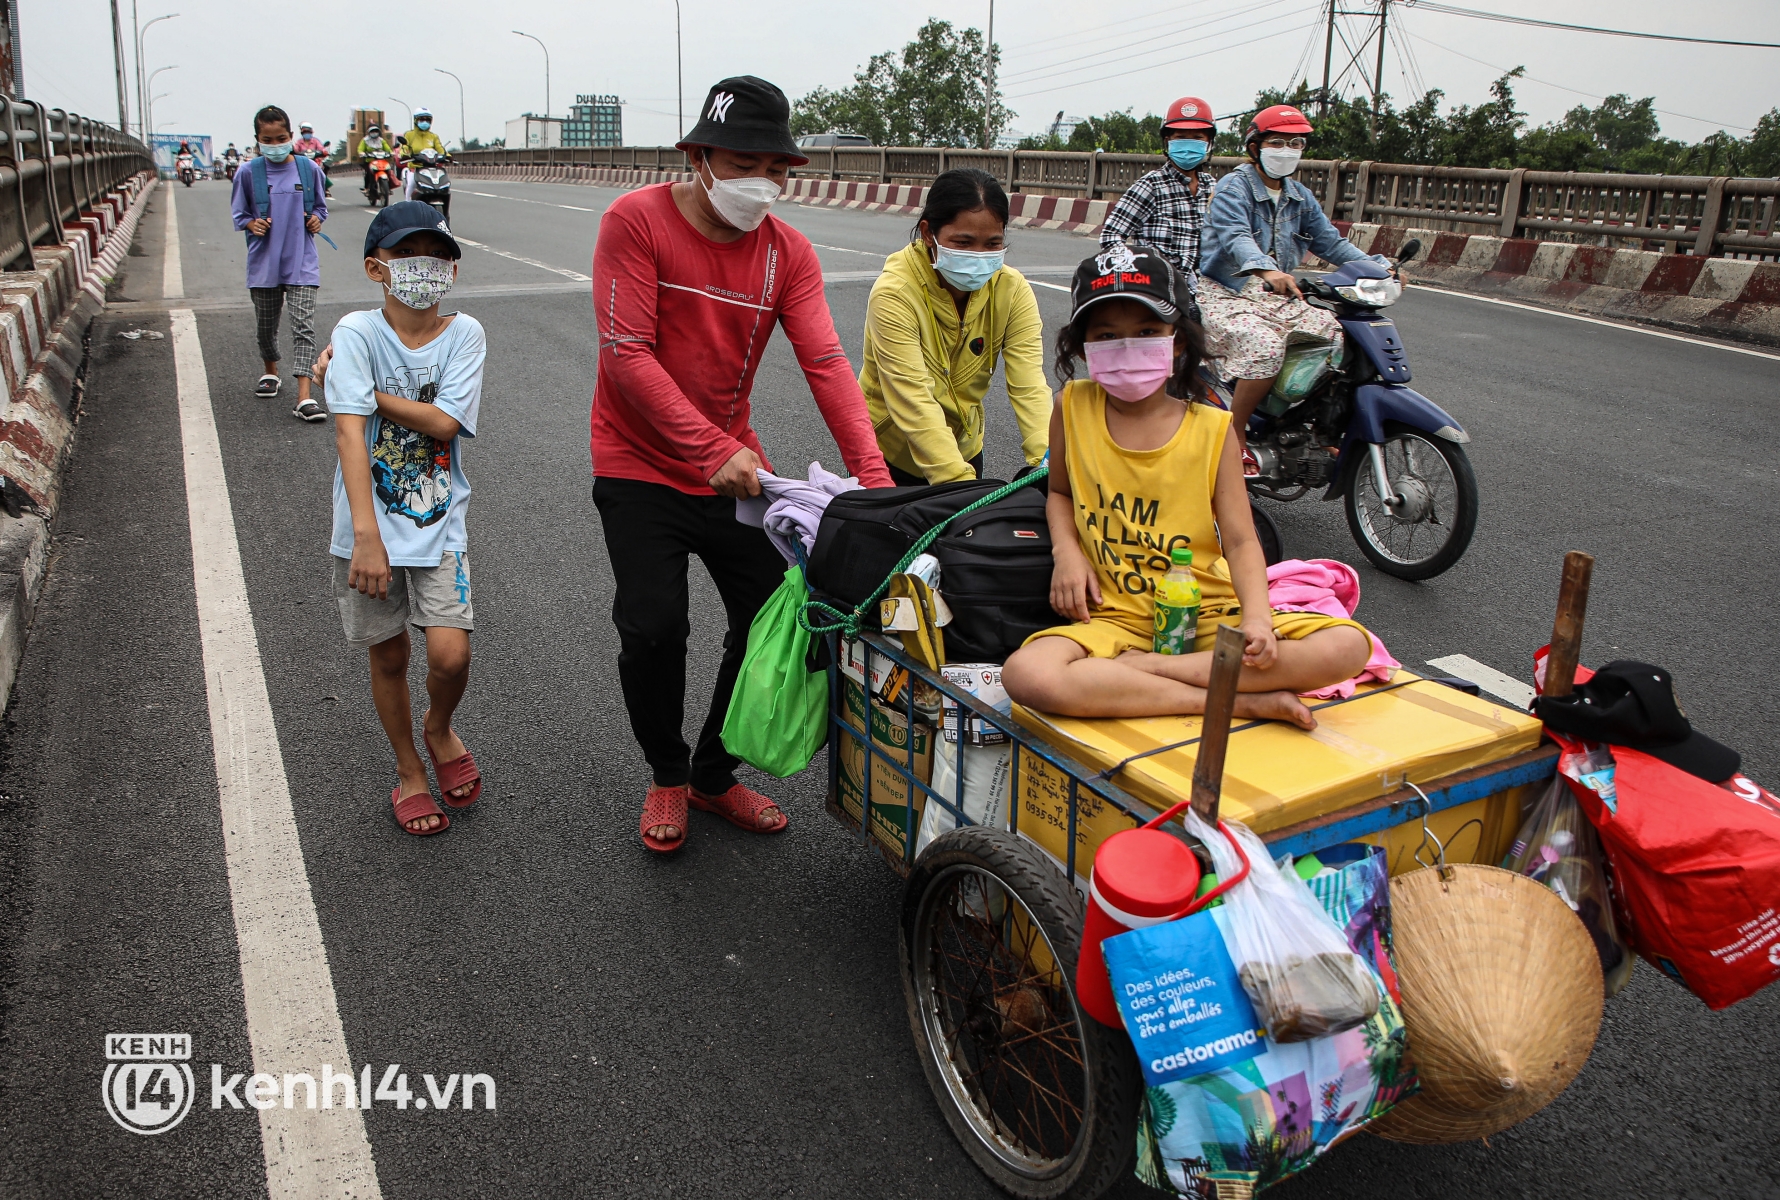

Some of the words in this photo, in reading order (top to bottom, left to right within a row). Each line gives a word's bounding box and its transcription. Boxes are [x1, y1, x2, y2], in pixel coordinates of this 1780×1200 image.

[707, 91, 735, 124] NY
[1090, 274, 1116, 291] TRUE
[1120, 273, 1151, 285] RLGN
[1096, 483, 1105, 509] I
[1110, 492, 1160, 527] AM
[1080, 504, 1191, 555] ALLING
[1093, 540, 1121, 566] IN
[892, 728, 903, 741] 10
[1709, 937, 1747, 958] because
[1745, 928, 1762, 941] this
[1761, 917, 1779, 931] bag
[1722, 950, 1745, 966] 50%
[1742, 929, 1777, 955] recycled
[1125, 979, 1153, 997] Des
[1154, 967, 1195, 987] idées,
[1130, 993, 1156, 1011] des
[1158, 975, 1217, 1001] couleurs,
[1134, 1006, 1165, 1025] vous
[1168, 996, 1196, 1016] allez
[1139, 1021, 1167, 1039] être
[1169, 1002, 1222, 1030] emballés
[1150, 1028, 1258, 1074] castorama
